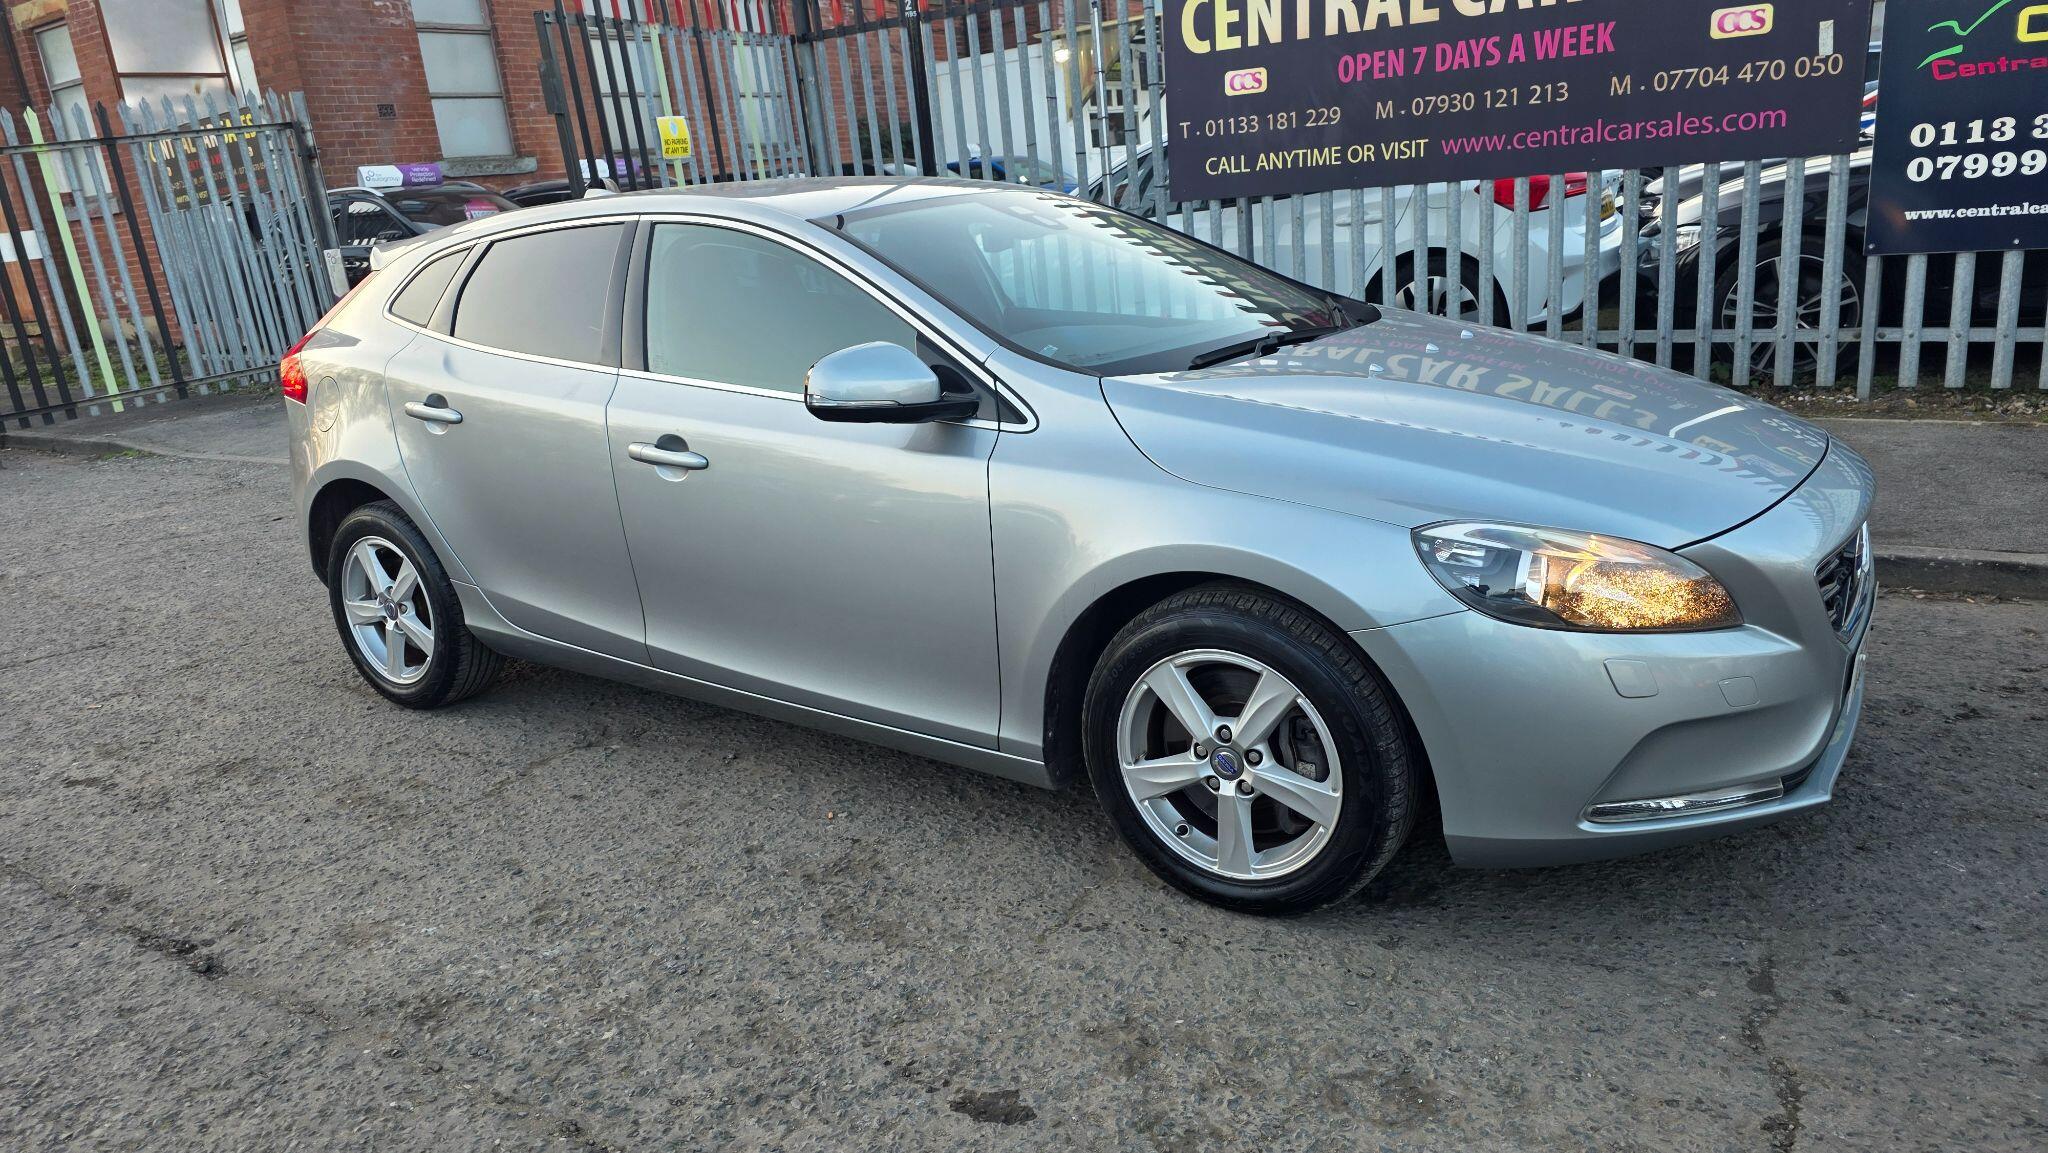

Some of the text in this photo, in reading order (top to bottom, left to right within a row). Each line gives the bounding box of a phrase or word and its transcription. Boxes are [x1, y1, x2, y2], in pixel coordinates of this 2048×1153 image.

[1338, 21, 1616, 84] OPEN 7 DAYS A WEEK
[1653, 64, 1730, 92] 07704
[1737, 59, 1786, 83] 470
[1795, 53, 1844, 78] 050
[1411, 91, 1475, 116] 07930
[1484, 87, 1518, 109] 121
[1528, 81, 1569, 105] 213
[1205, 115, 1259, 137] 01133
[1267, 111, 1297, 131] 181
[1304, 106, 1341, 127] 229
[1910, 116, 2017, 148] 0113
[1205, 109, 1787, 175] CALL ANYTIME OR VISIT www.centralcarsales.com
[1906, 149, 2048, 182] 07999
